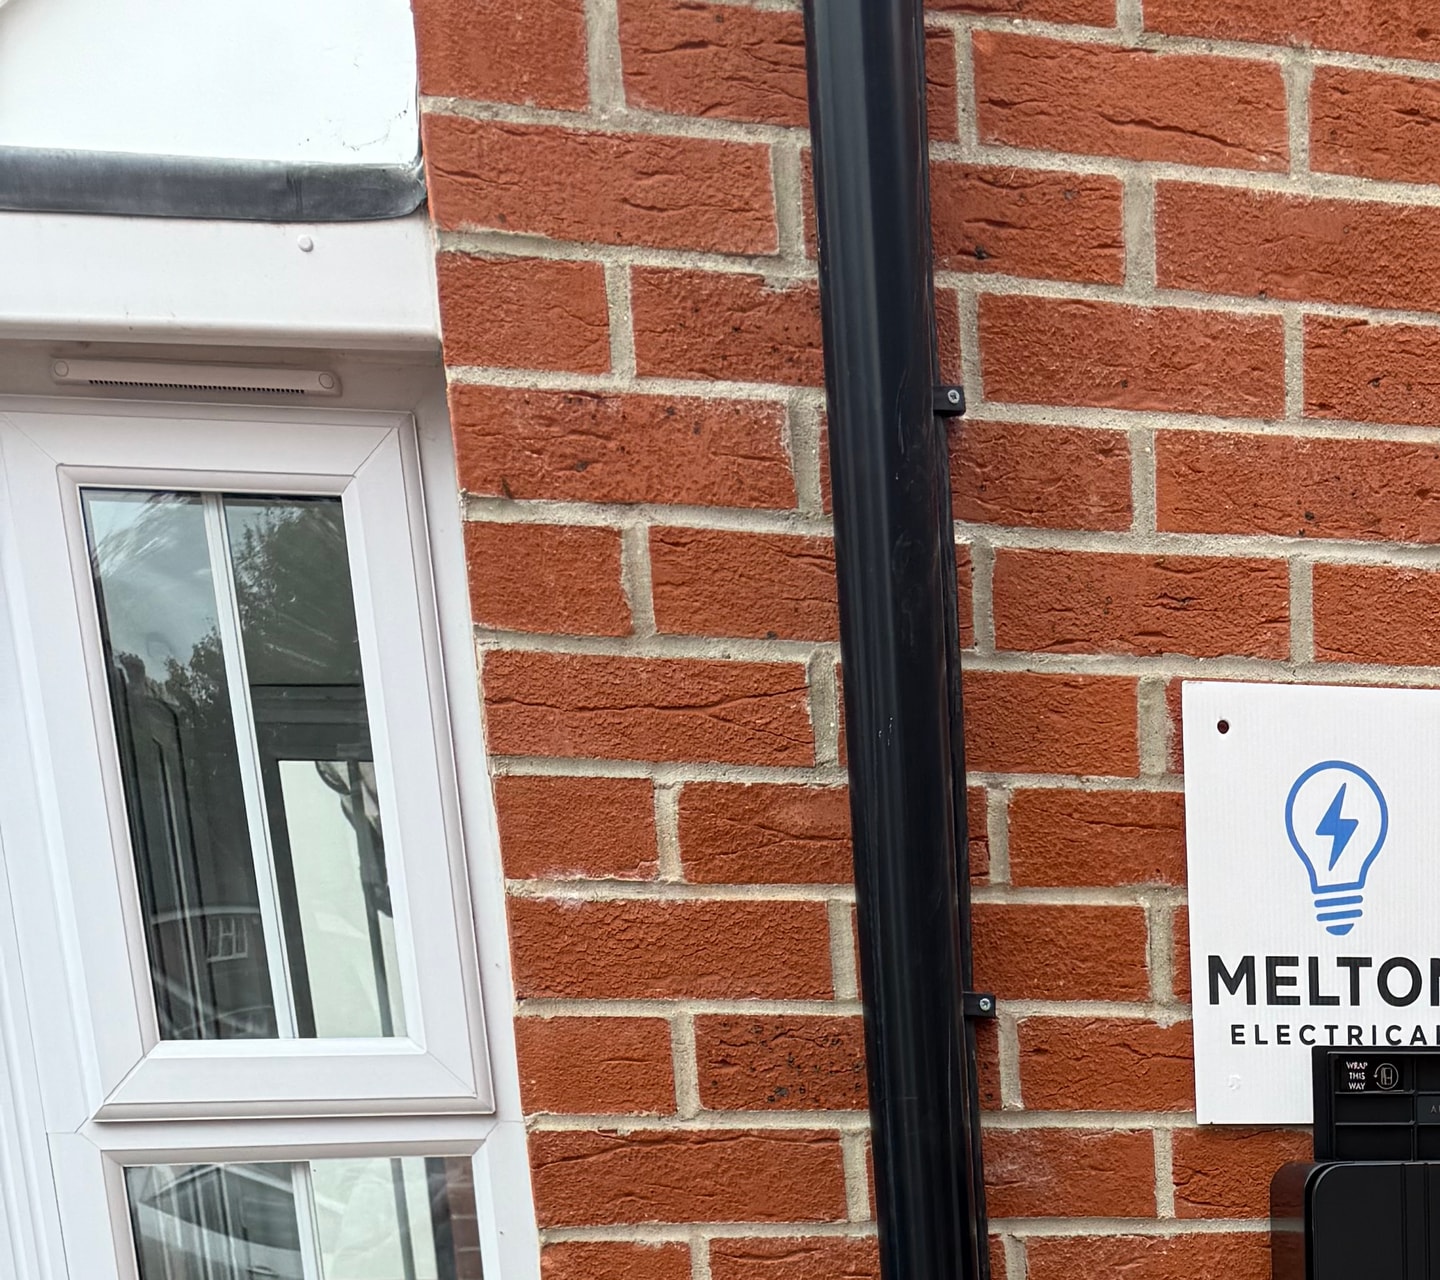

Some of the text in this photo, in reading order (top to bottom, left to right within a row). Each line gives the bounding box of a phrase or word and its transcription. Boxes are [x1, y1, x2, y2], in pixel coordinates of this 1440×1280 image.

[1346, 1061, 1368, 1070] WRAP
[1349, 1071, 1366, 1080] THIS
[1348, 1082, 1366, 1090] WAY
